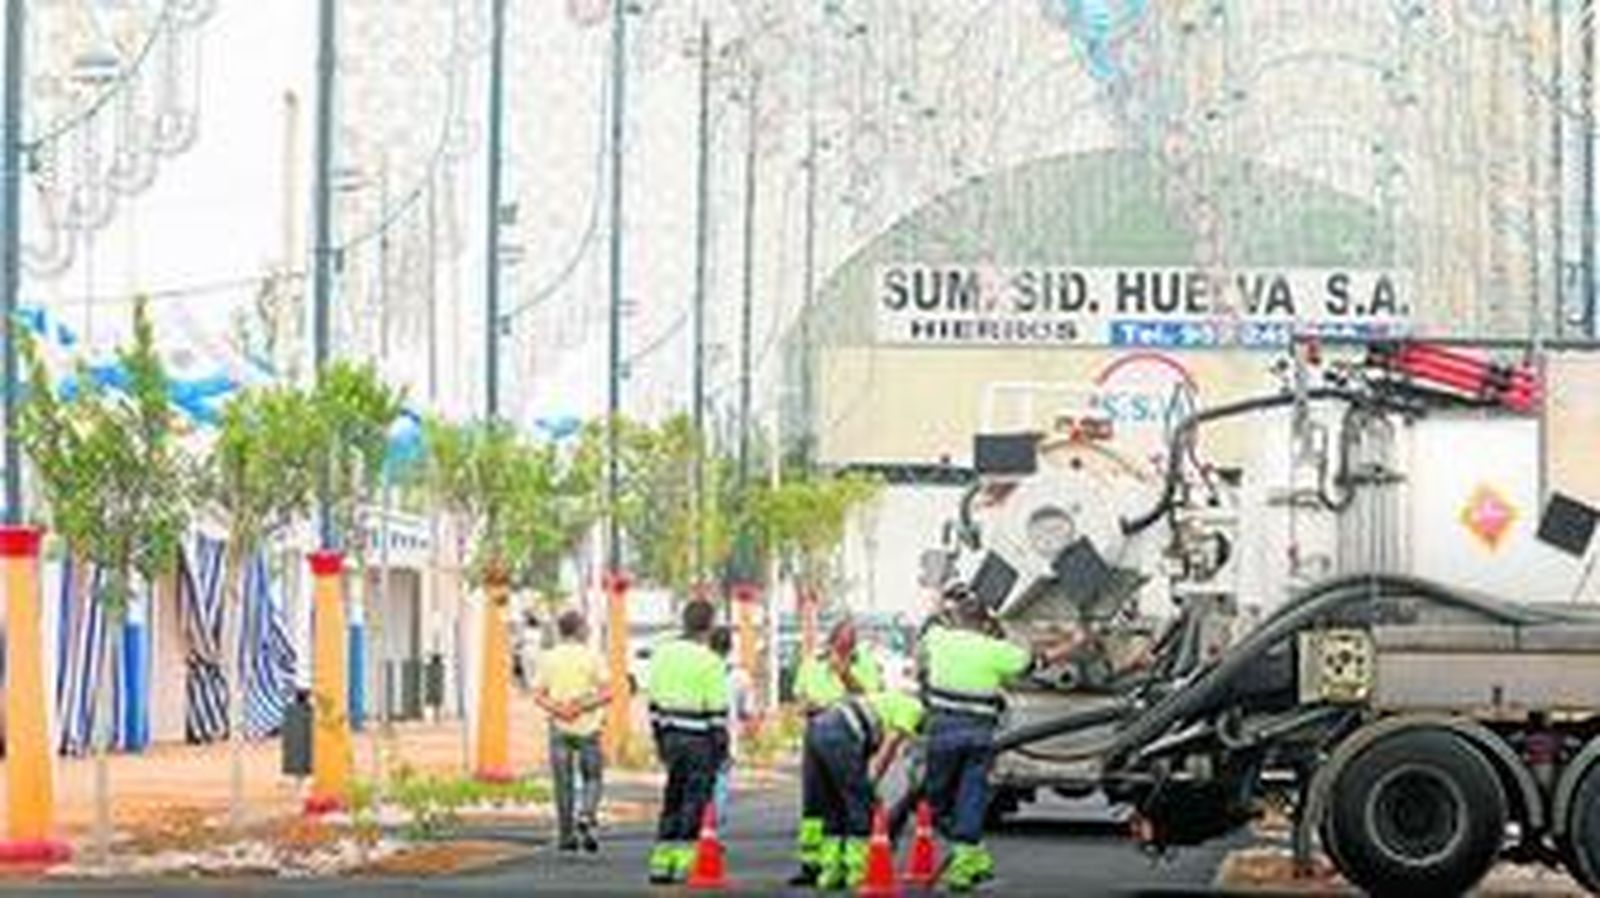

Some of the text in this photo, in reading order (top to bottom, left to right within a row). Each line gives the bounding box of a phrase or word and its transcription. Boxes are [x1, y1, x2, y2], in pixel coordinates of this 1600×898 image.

[1011, 271, 1098, 313] SID.
[1116, 272, 1295, 313] HUEVA
[1325, 273, 1411, 314] S.A.
